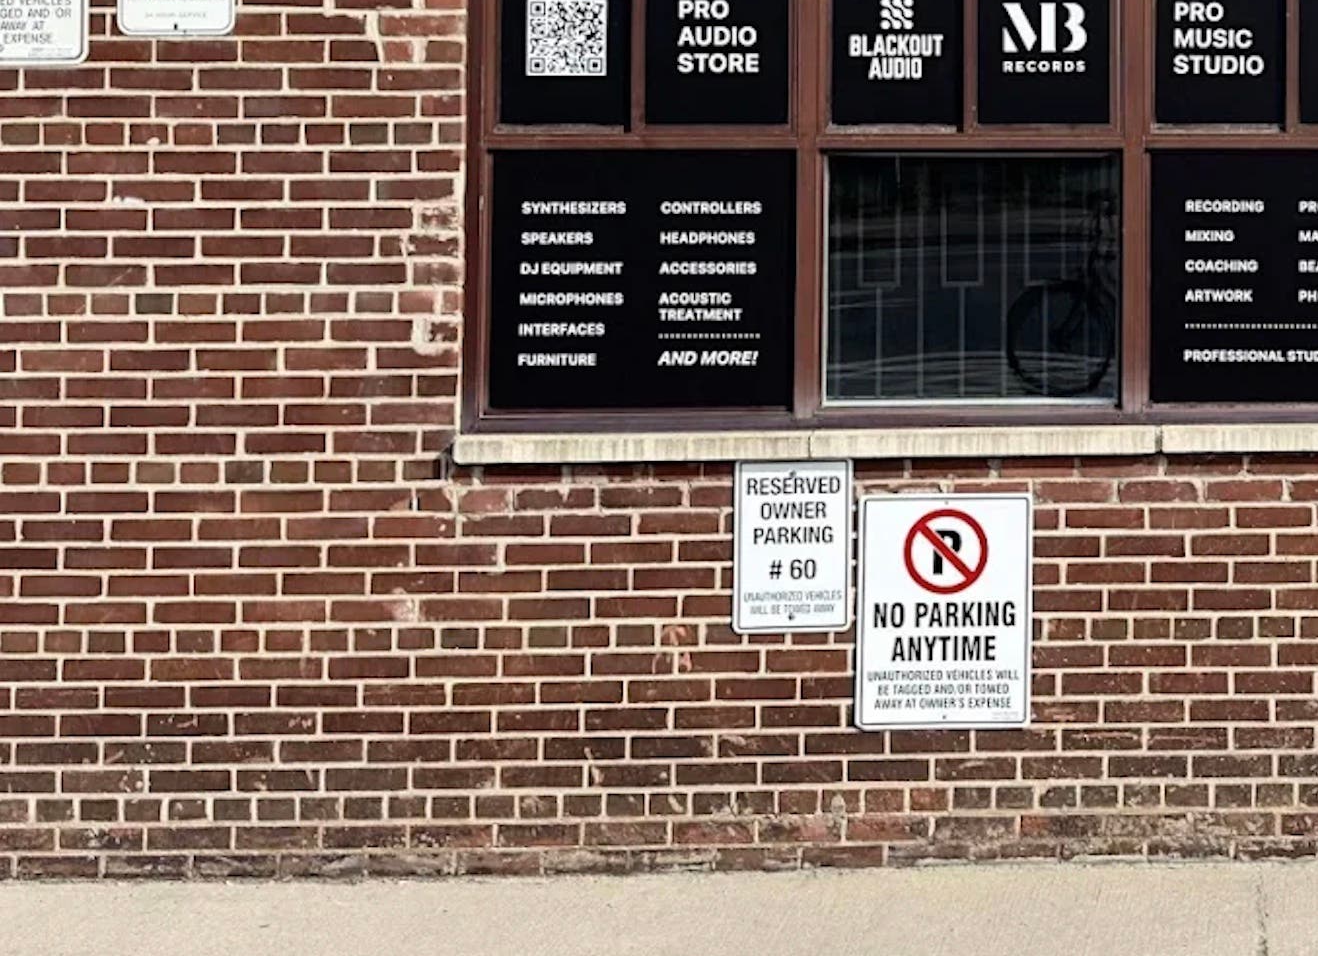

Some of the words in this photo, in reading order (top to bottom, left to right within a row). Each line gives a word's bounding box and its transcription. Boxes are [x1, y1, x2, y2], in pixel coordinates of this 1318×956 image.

[679, 0, 729, 19] PRO
[1175, 2, 1224, 21] PRO
[1003, 3, 1087, 52] MB
[678, 26, 756, 46] AUDIO
[1174, 28, 1252, 48] MUSIC
[850, 34, 943, 58] BLACKOUT
[678, 53, 759, 72] STORE
[869, 58, 922, 79] AUDIO
[1003, 61, 1085, 72] RECORDS
[1174, 55, 1264, 75] STUDIO
[522, 201, 626, 214] SYNTHESIZERS
[661, 201, 762, 214] CONTROLLERS
[1185, 200, 1264, 212] RECORDING
[521, 232, 593, 245] SPEAKERS
[660, 232, 755, 244] HEADPHONES
[1185, 230, 1235, 241] MIXING
[520, 263, 539, 274] DJ
[541, 262, 623, 275] EQUIPMENT
[660, 262, 756, 274] ACCESSORIES
[1185, 260, 1258, 272] COACHING
[520, 293, 623, 305] MICROPHONES
[659, 292, 731, 305] ACOUSTIC
[1185, 289, 1252, 302] ARTWORK
[659, 308, 742, 321] TREATMENT
[519, 323, 605, 336] INTERFACES
[518, 353, 596, 366] FURNITURE
[658, 351, 698, 365] AND
[701, 351, 758, 365] MORE!
[1184, 349, 1285, 362] PROFESSIONAL
[747, 476, 840, 495] RESERVED
[761, 501, 827, 520] OWNER
[754, 526, 833, 544] PARKING
[770, 561, 782, 579] #
[791, 559, 816, 579] 60
[874, 603, 904, 628] NO
[916, 601, 1015, 627] PARKING
[892, 636, 995, 661] ANYTIME
